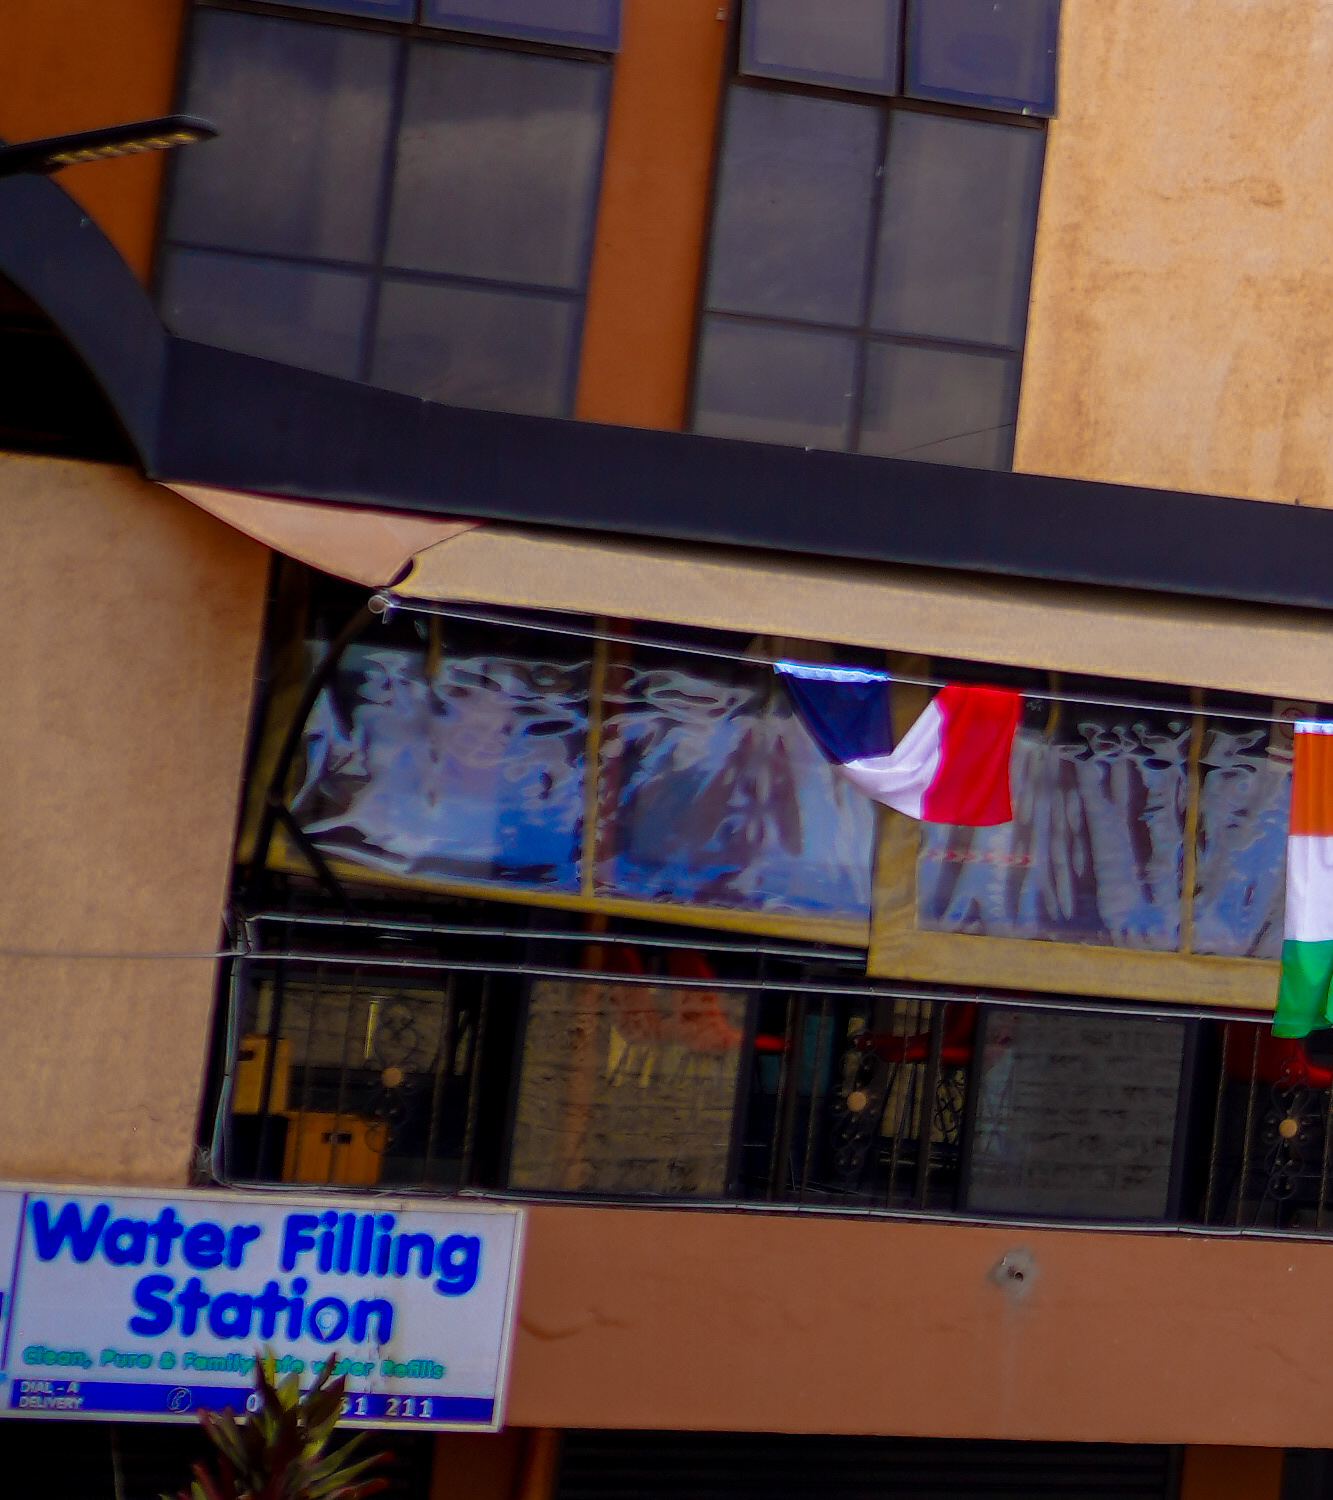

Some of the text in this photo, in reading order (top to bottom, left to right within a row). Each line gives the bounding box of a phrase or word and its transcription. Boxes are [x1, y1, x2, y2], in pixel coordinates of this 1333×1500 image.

[31, 1200, 482, 1296] Water Filling
[128, 1274, 394, 1345] Station
[23, 1345, 92, 1369] Clean,
[100, 1349, 151, 1369] Pure
[20, 1381, 54, 1394] DIAL
[19, 1395, 86, 1409] DELIVERY
